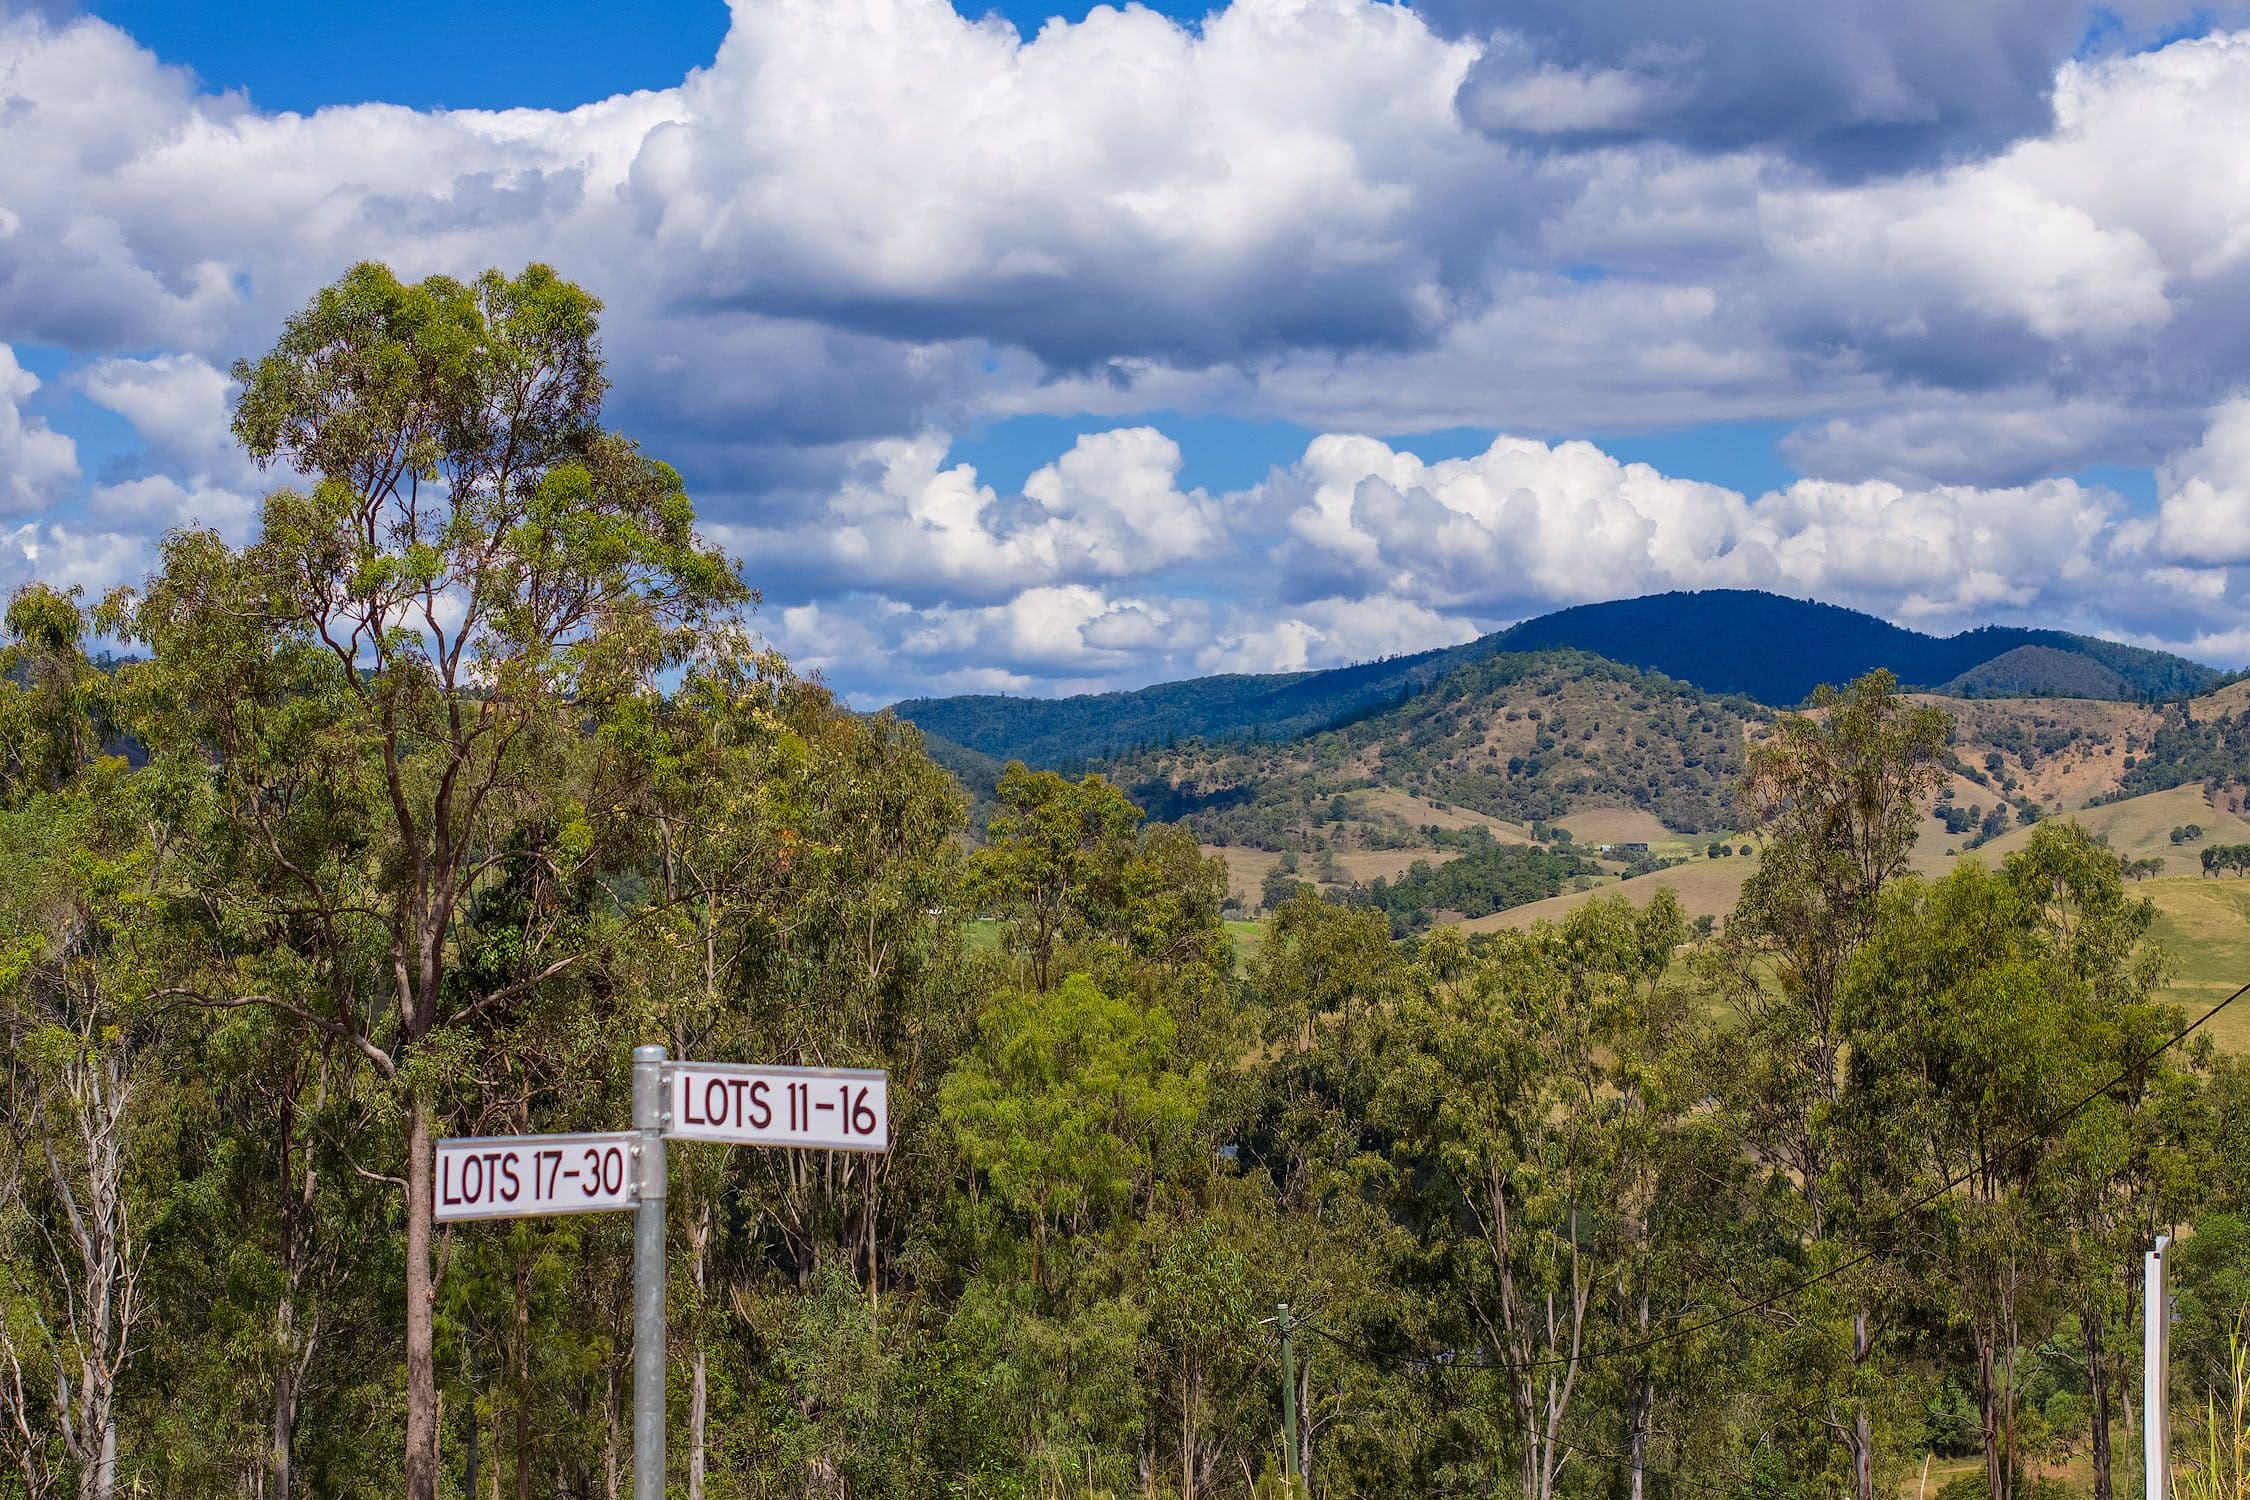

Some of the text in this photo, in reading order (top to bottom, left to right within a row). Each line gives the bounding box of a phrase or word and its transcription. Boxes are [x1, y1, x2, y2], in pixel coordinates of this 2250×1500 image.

[684, 1075, 877, 1136] LOTS 11-16
[442, 1146, 624, 1206] LOTS 17-30
